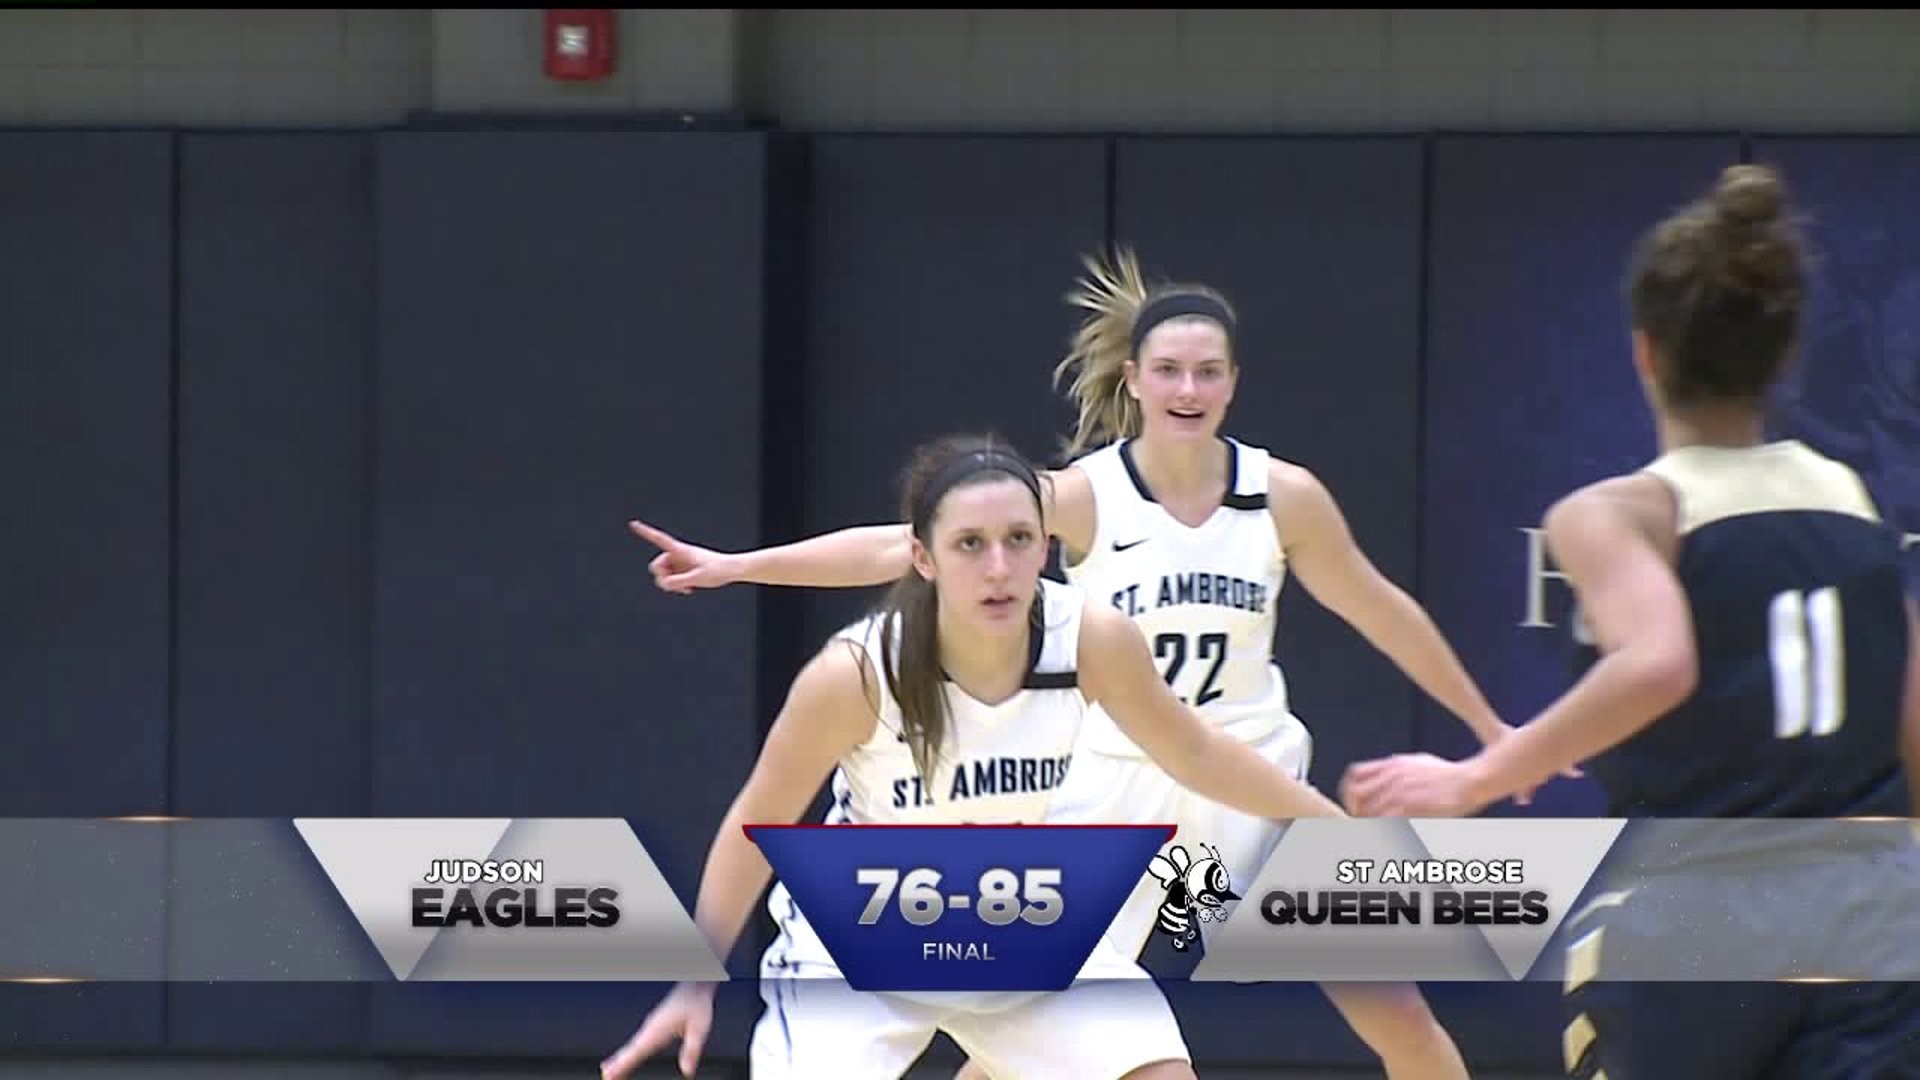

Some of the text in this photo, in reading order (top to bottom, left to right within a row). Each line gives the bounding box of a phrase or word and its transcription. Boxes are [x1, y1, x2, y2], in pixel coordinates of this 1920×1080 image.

[1154, 632, 1228, 706] 22
[1769, 586, 1845, 738] 11
[949, 754, 1073, 801] AMBROS
